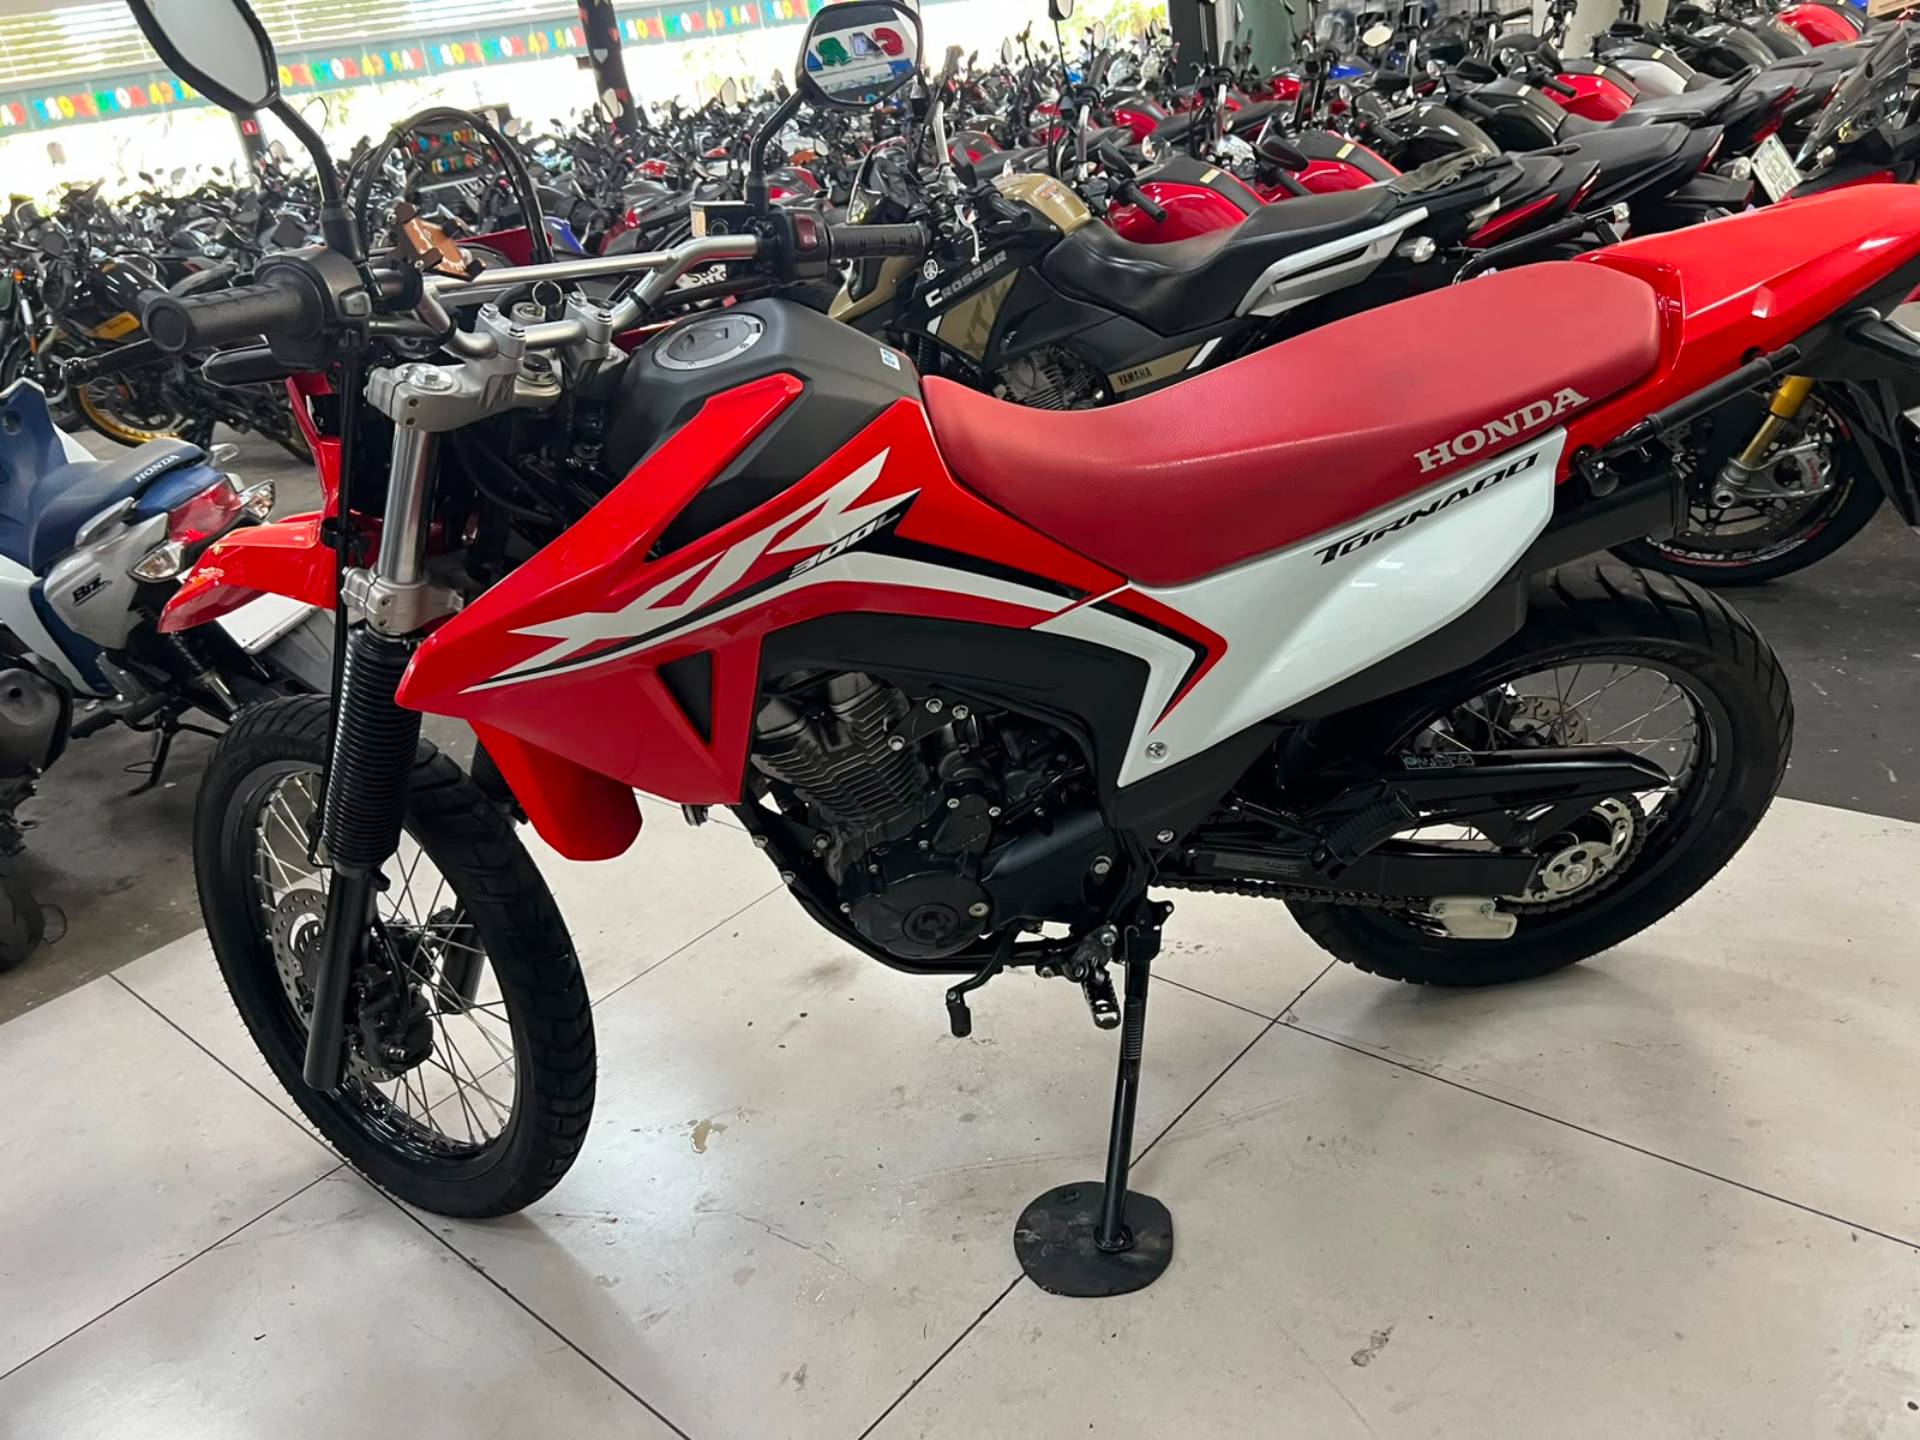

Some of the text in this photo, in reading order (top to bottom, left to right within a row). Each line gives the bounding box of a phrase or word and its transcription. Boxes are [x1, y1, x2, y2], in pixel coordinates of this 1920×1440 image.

[925, 249, 1008, 308] CROSSER
[1117, 365, 1153, 387] YAMAHA
[1413, 387, 1590, 474] HONDA
[134, 454, 181, 483] HONDA
[1313, 452, 1539, 566] TORNADO
[788, 513, 901, 579] 300L
